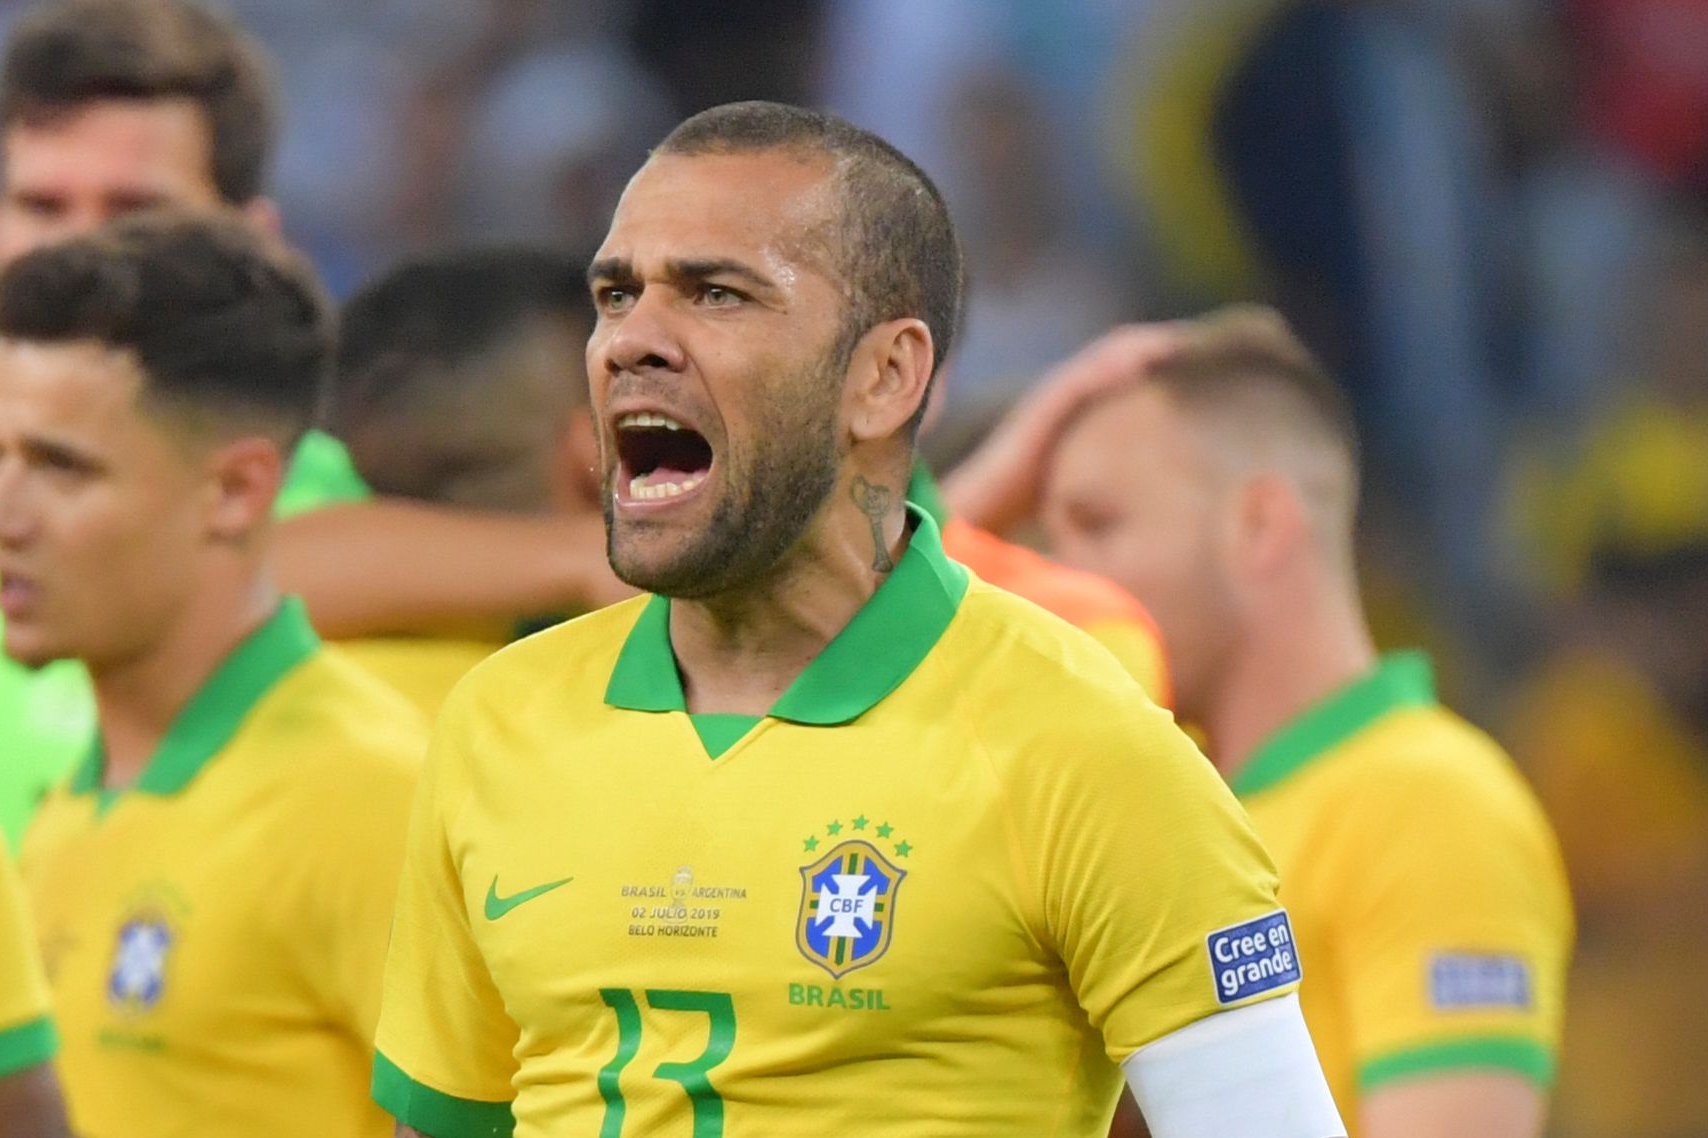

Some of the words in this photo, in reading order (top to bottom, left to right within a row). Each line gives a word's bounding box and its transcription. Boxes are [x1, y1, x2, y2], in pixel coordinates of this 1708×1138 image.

[621, 885, 667, 898] BRASIL
[692, 886, 747, 899] ARGENTINA
[829, 898, 864, 913] CBF
[631, 907, 646, 918] 02
[649, 907, 687, 920] JULIO
[691, 908, 720, 920] 2019
[628, 924, 655, 936] BELO
[657, 925, 718, 938] HORIZONTE
[1214, 931, 1267, 963] Cree
[1268, 924, 1290, 947] en
[1221, 948, 1293, 996] grande
[788, 982, 891, 1011] BRASIL
